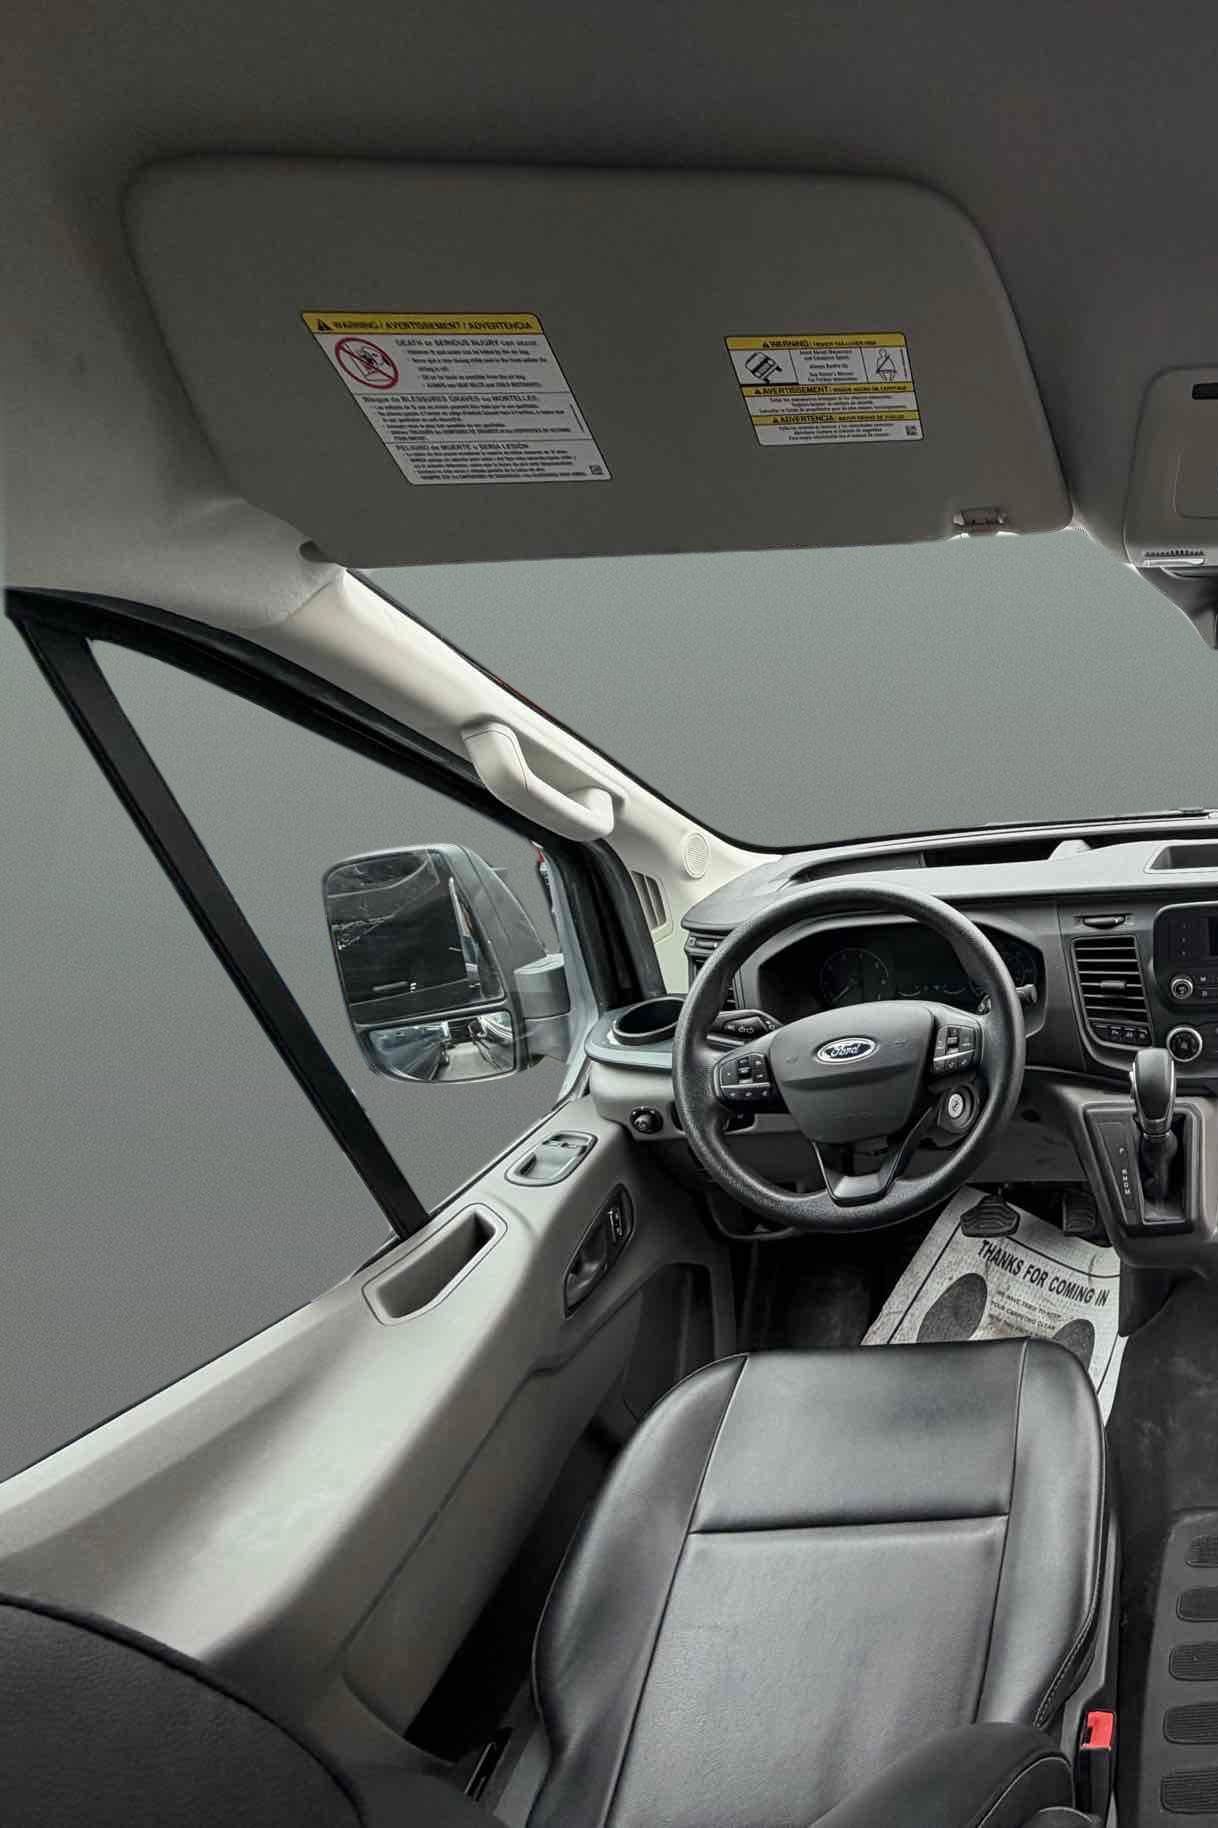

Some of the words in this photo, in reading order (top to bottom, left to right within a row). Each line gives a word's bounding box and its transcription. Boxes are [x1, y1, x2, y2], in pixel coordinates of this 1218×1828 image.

[334, 321, 379, 330] WARNING
[386, 321, 460, 330] AVERTISSEMENT
[468, 321, 533, 330] ADVERTENCIA
[831, 1044, 859, 1057] Ford
[977, 1239, 1025, 1276] THANKS
[1022, 1263, 1049, 1289] FOR
[1048, 1276, 1095, 1304] COMING
[1094, 1288, 1110, 1307] IN
